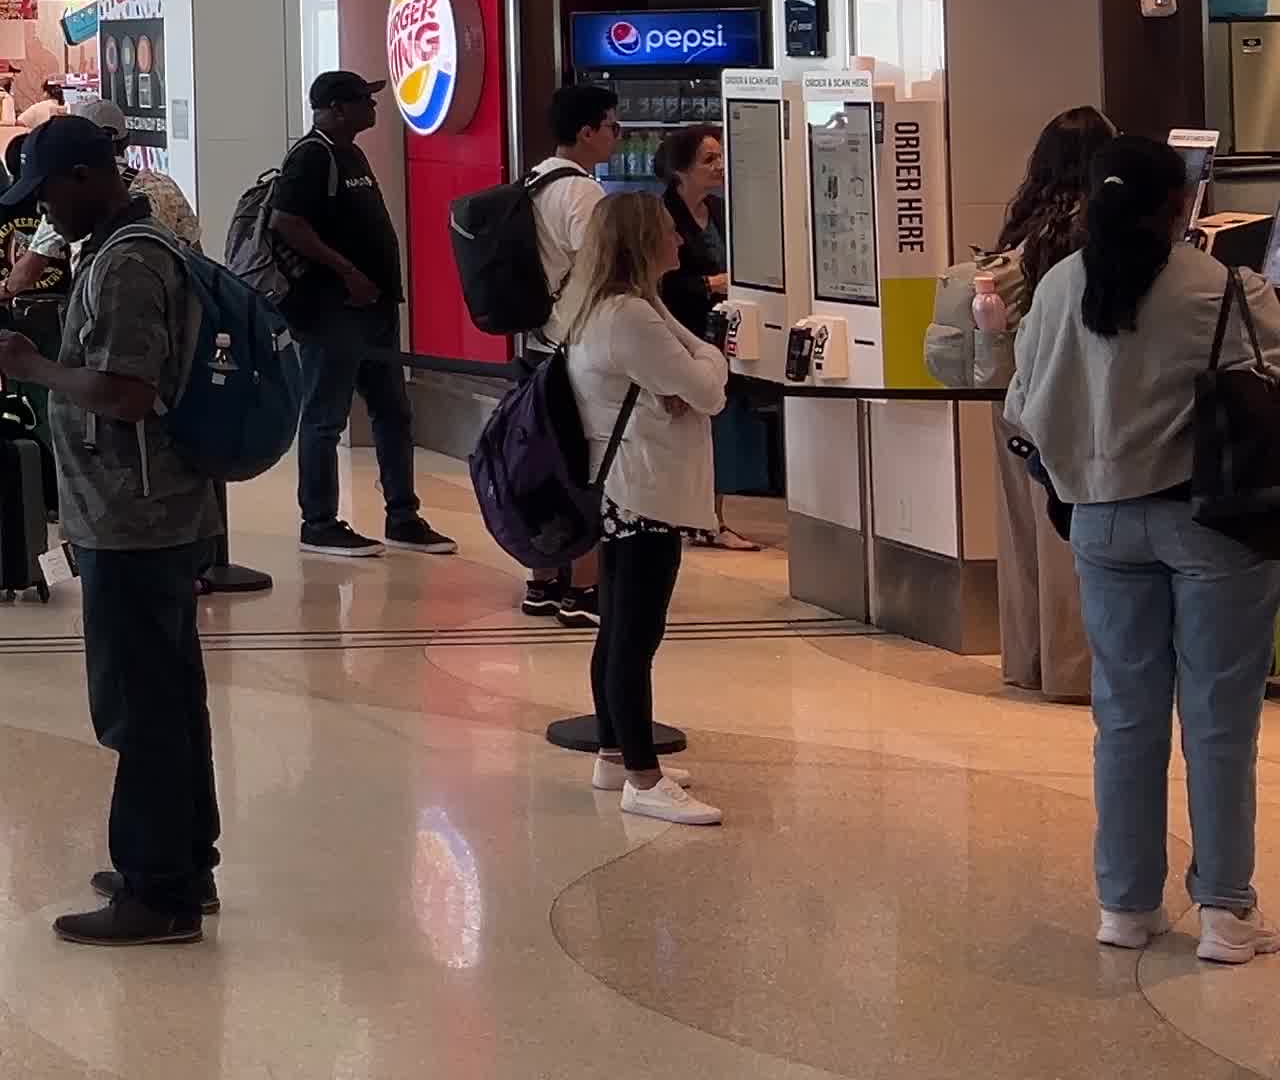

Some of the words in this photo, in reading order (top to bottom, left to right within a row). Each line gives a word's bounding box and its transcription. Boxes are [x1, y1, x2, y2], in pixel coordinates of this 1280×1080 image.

[646, 24, 723, 52] pepsi
[895, 122, 921, 191] ORDER
[897, 198, 924, 253] HERE
